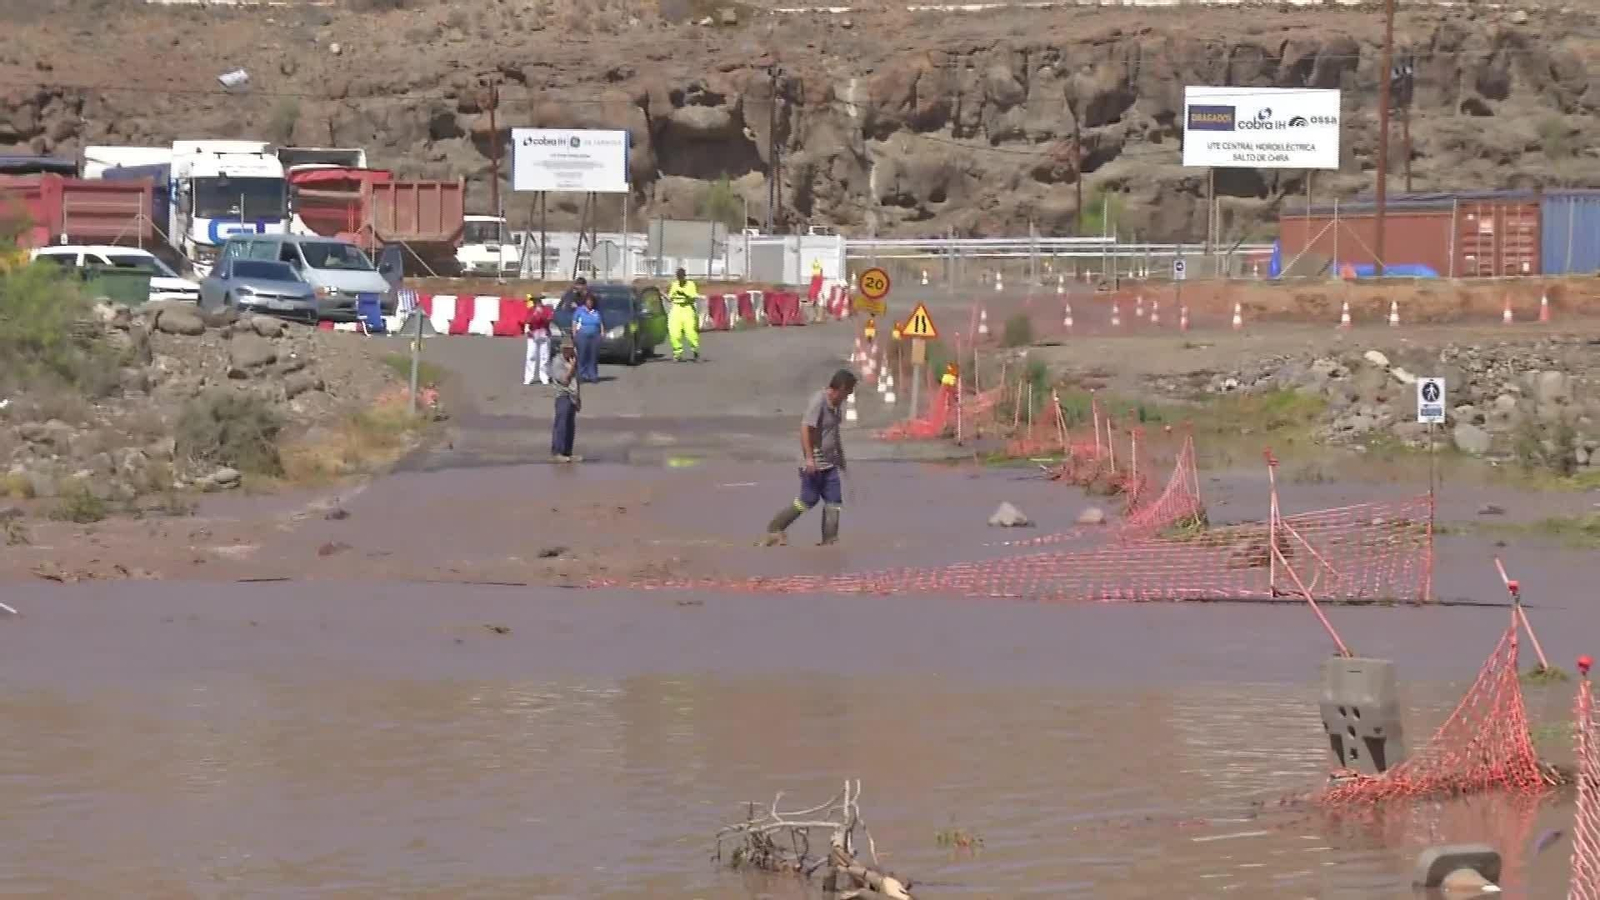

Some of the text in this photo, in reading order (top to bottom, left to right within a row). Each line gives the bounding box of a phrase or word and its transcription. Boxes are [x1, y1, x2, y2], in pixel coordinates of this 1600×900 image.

[1238, 116, 1273, 129] cobra
[1222, 142, 1253, 150] CENTRAL
[865, 277, 884, 289] 20
